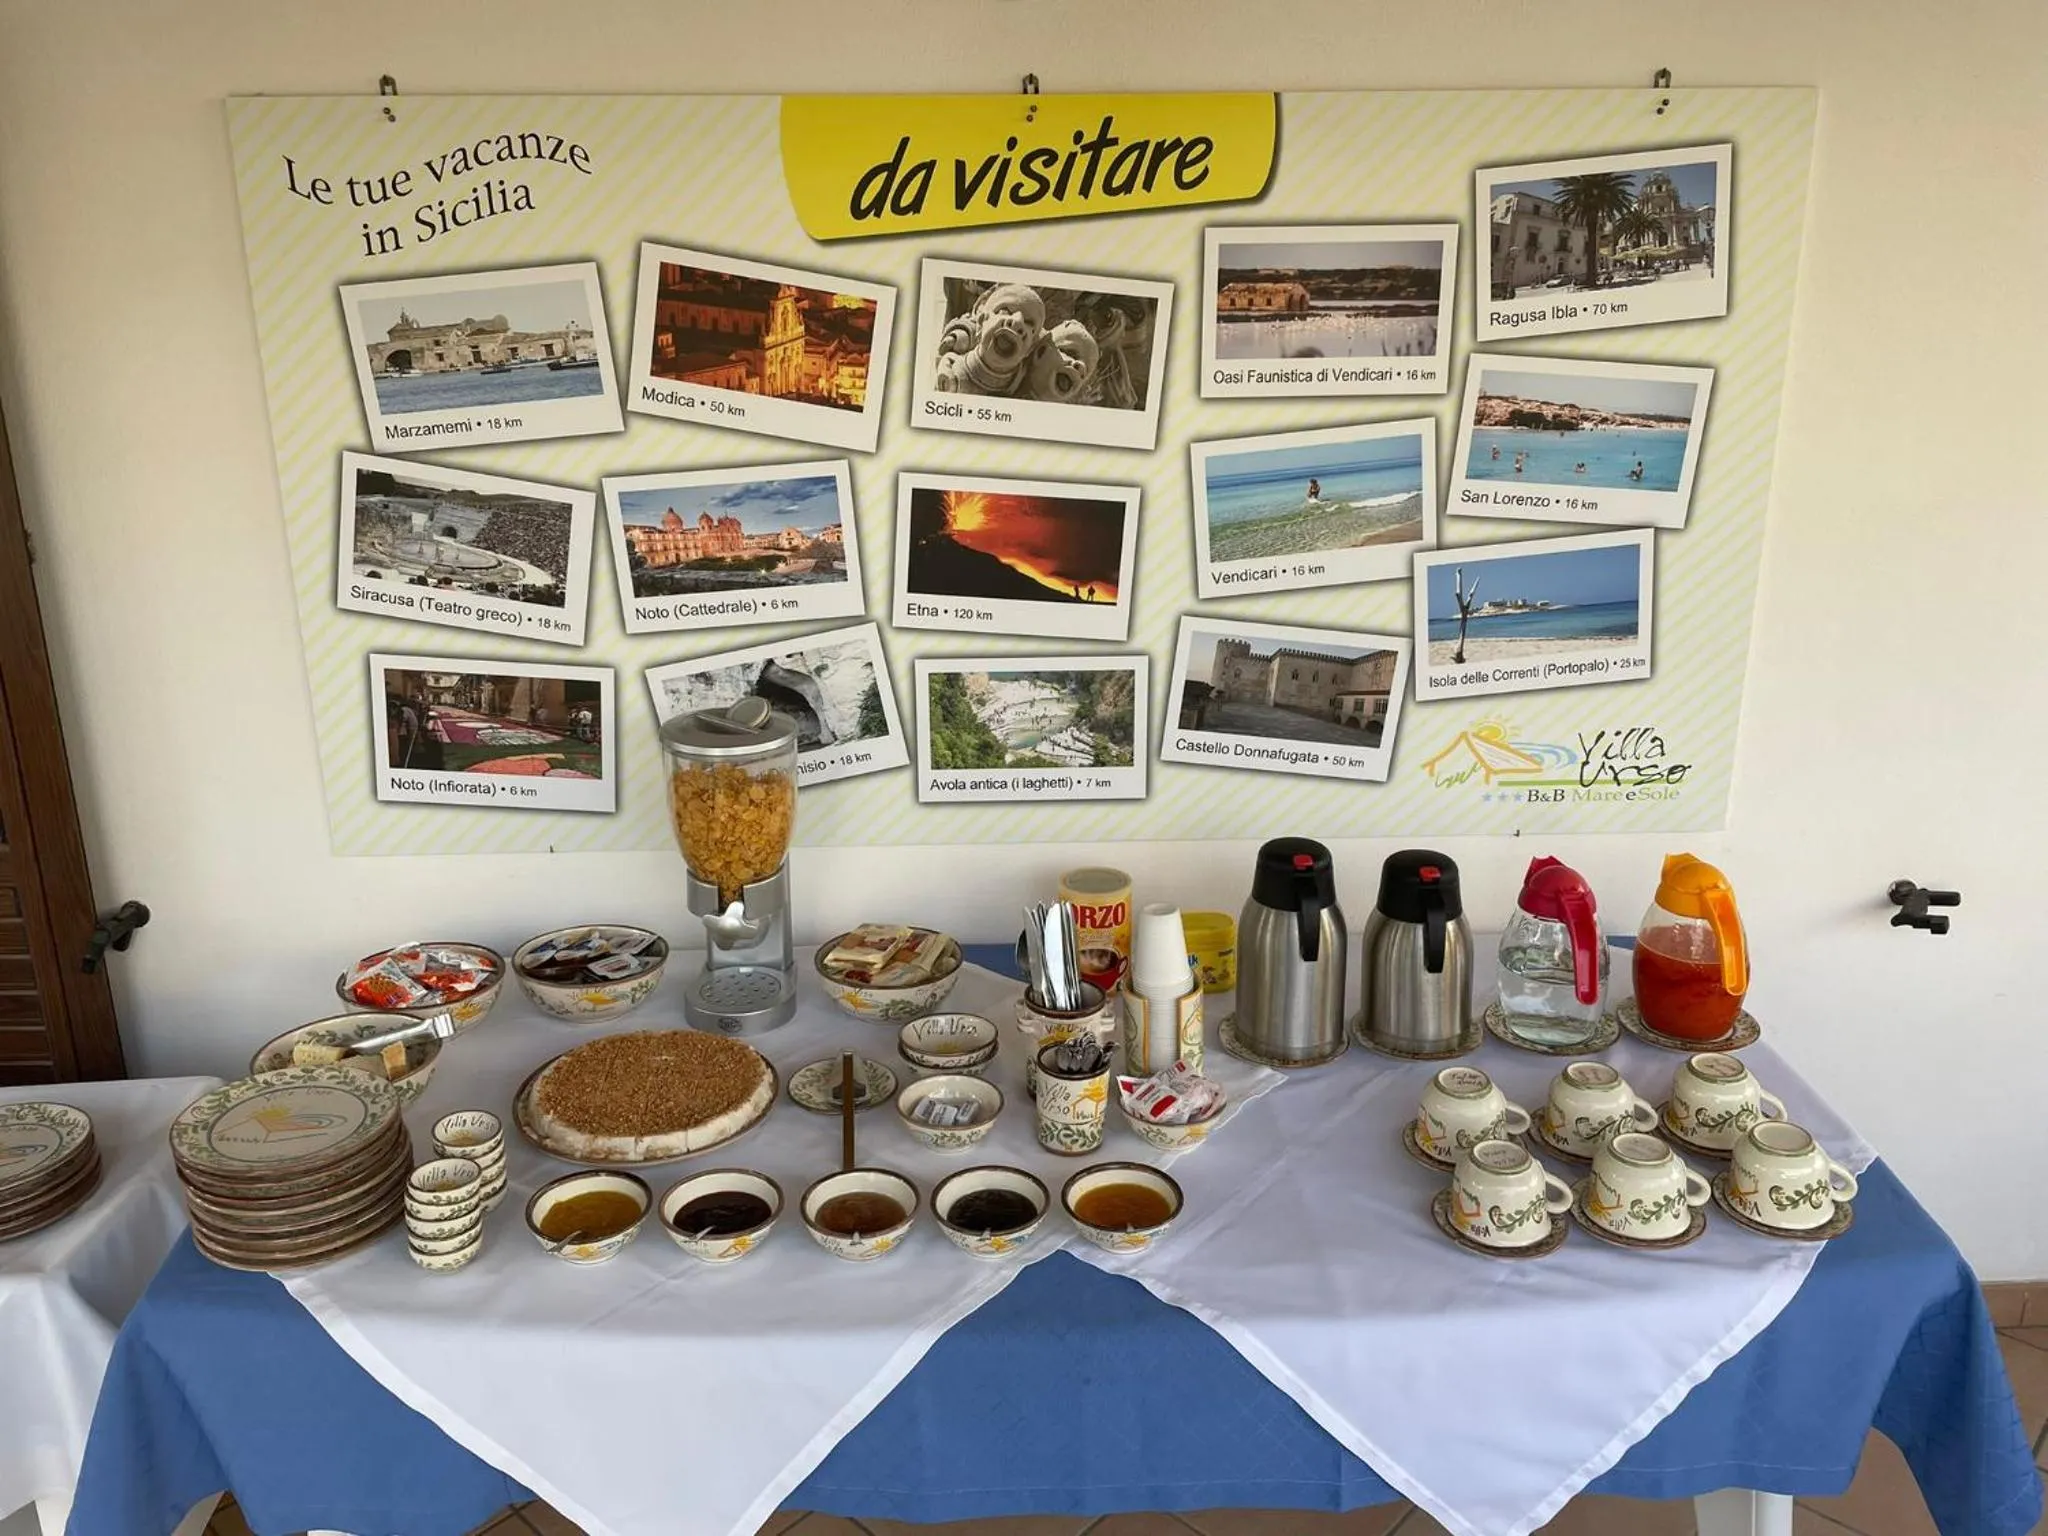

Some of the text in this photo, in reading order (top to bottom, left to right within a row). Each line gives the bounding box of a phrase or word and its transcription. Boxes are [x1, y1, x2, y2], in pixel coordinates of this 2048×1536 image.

[282, 131, 593, 208] Le tue vacanze
[849, 115, 1214, 220] da visitare
[361, 179, 536, 257] in Sicilia
[1490, 302, 1628, 328] Ragusa Ibla 70 km
[1213, 367, 1436, 384] Oasi Faunistica di Vendicari 16 km
[641, 386, 746, 417] Modica 50 km
[924, 400, 1012, 423] Scicli 55 km
[385, 417, 523, 440] Marzamemi 18 km
[1461, 489, 1598, 511] San Lorenzo 16 km
[1211, 564, 1325, 585] Vendicari 16 km
[350, 585, 571, 632] Siracusa (Teatro greco) 18 km
[635, 598, 799, 620] Noto (Cattedrale) 6 km
[906, 603, 993, 620] Etna 120 km
[1429, 657, 1646, 688] Isola delle Correnti (Portopalo) 25 km
[1176, 738, 1365, 768] Castello Donnafugata 50 km
[1578, 726, 1666, 761] Villa
[797, 759, 827, 776] nisio
[839, 753, 854, 766] 18
[854, 752, 872, 764] km
[1578, 760, 1692, 788] Urso
[391, 777, 538, 797] Noto (Infiorata) 6 km
[930, 776, 1111, 792] Avola antica (i laghetti) 7 km
[1526, 788, 1566, 803] B&B
